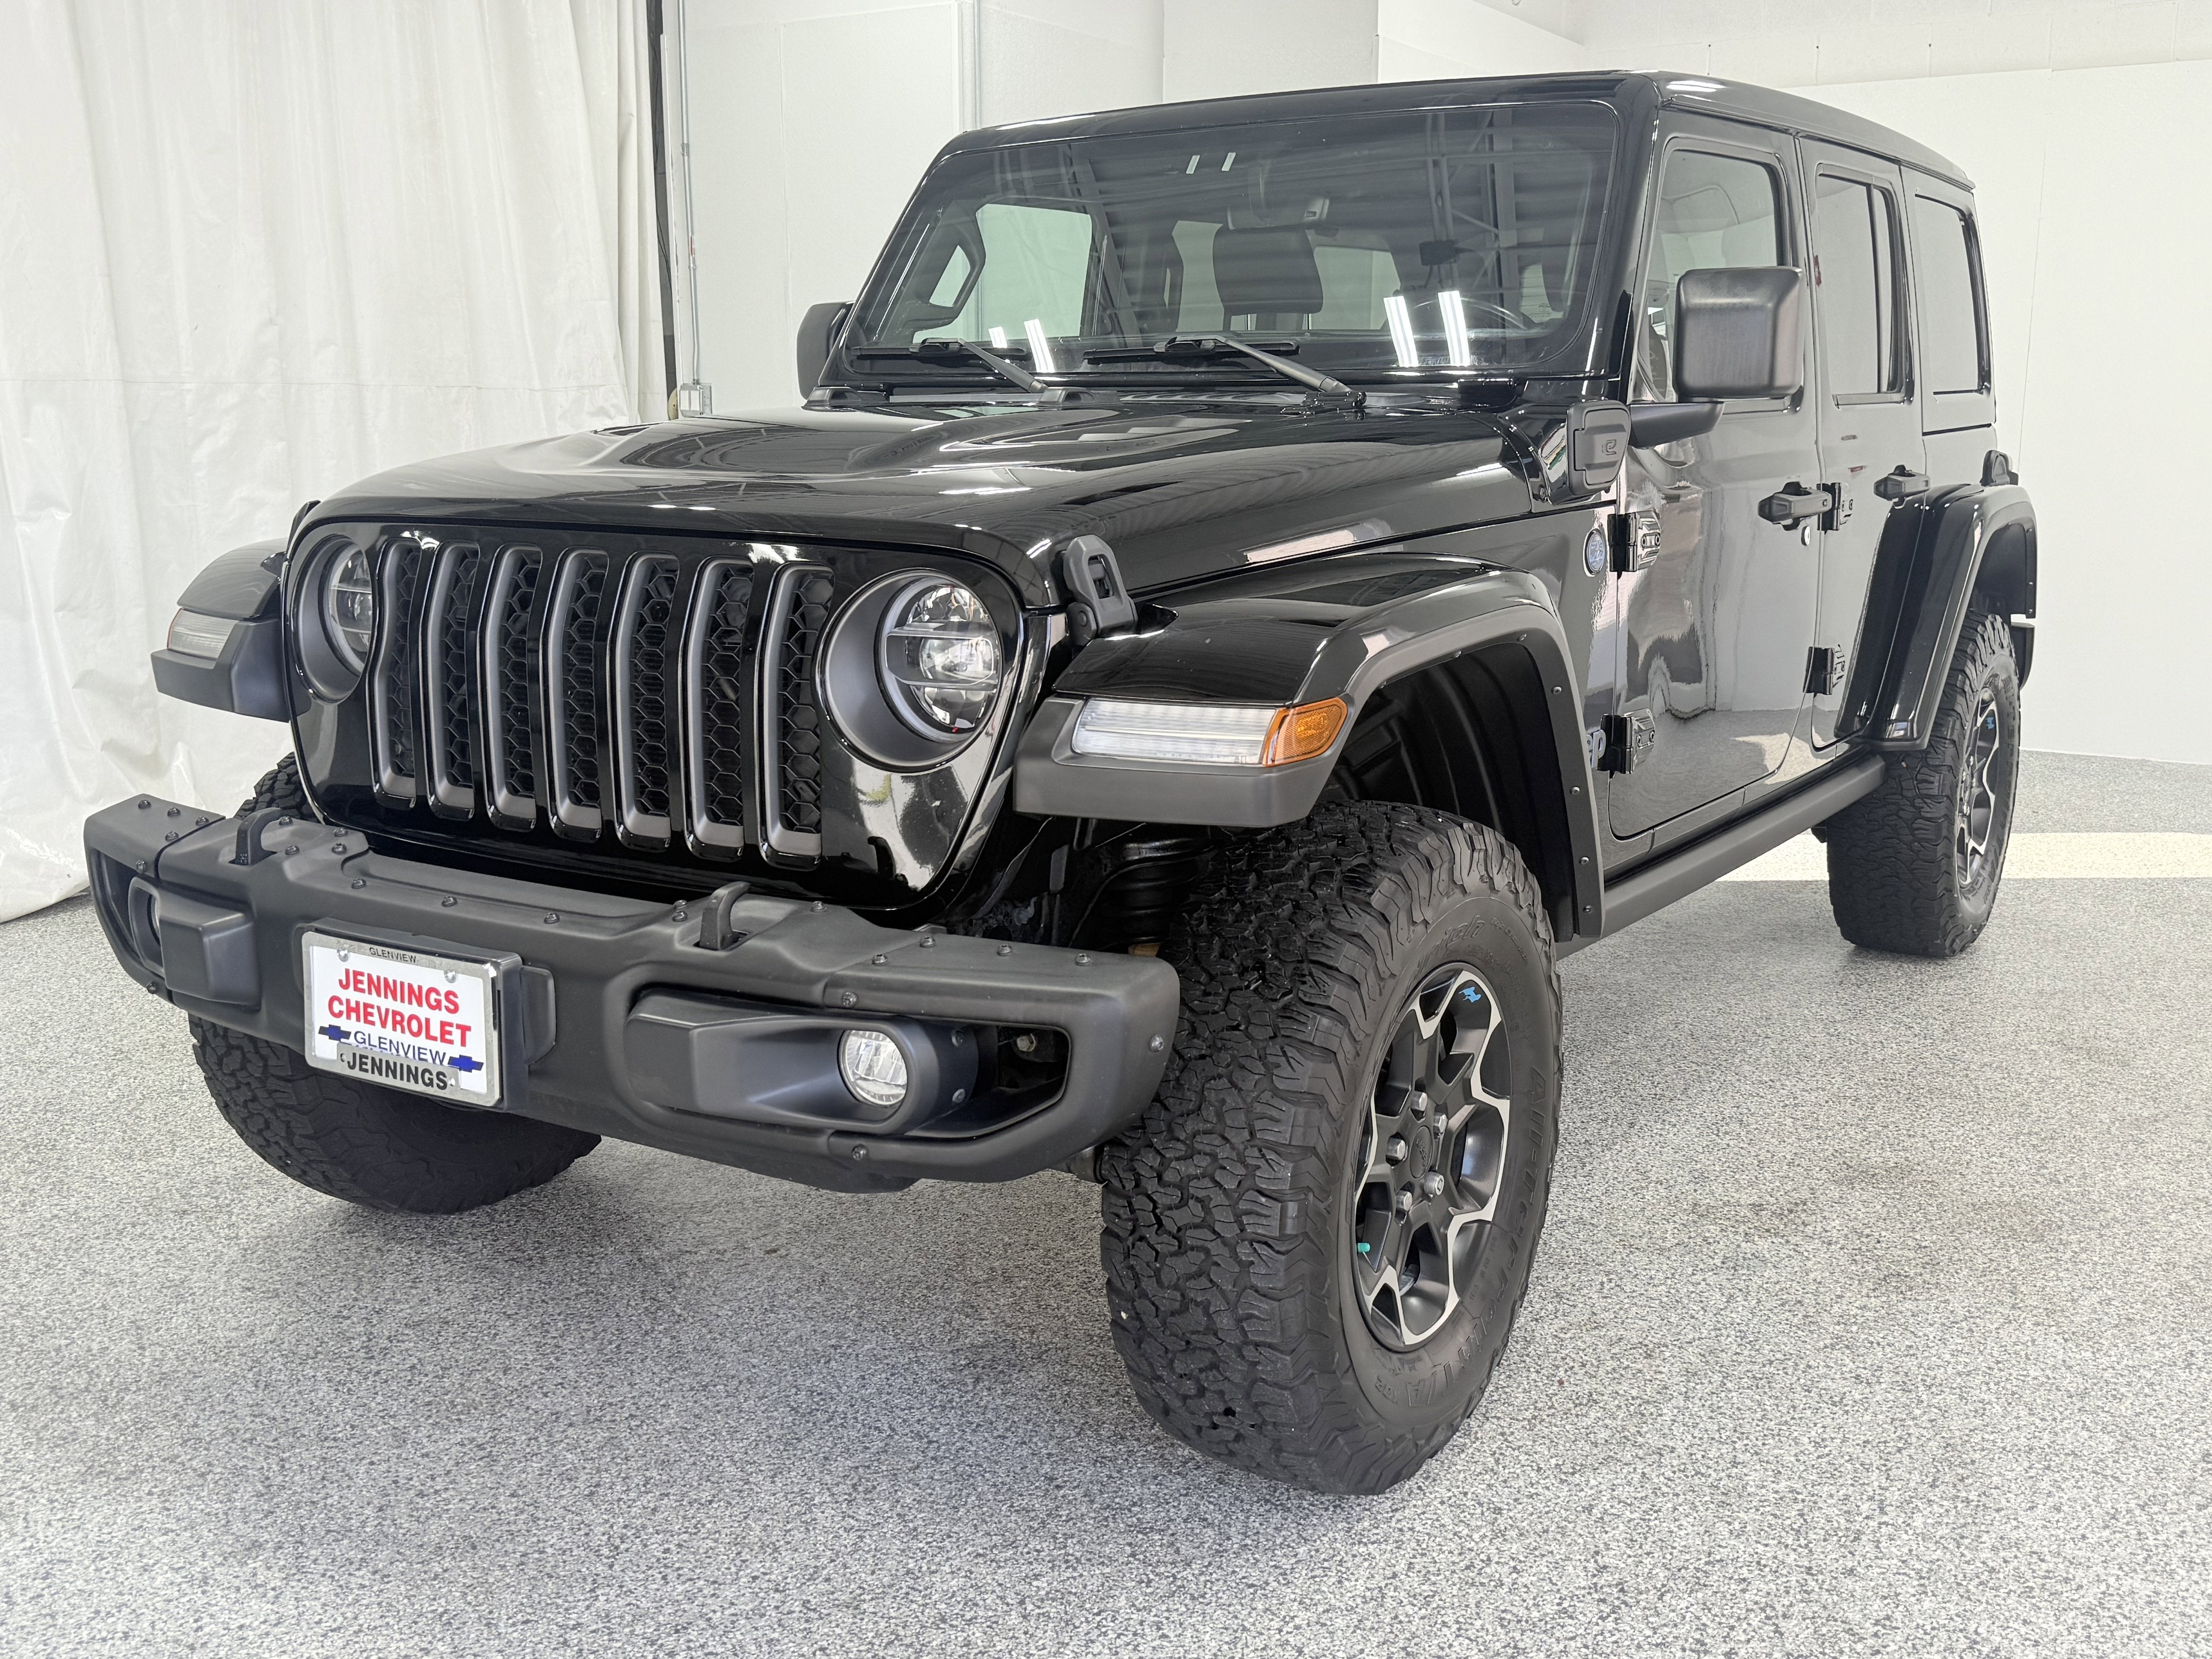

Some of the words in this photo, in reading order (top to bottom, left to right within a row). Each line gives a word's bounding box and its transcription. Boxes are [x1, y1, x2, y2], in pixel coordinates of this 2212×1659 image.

[369, 947, 416, 963] GLENVIEW
[338, 968, 460, 1014] JENNINGS
[328, 995, 471, 1047] CHEVROLET
[354, 1030, 446, 1065] GLENVIEW
[347, 1052, 448, 1090] JENNINGS
